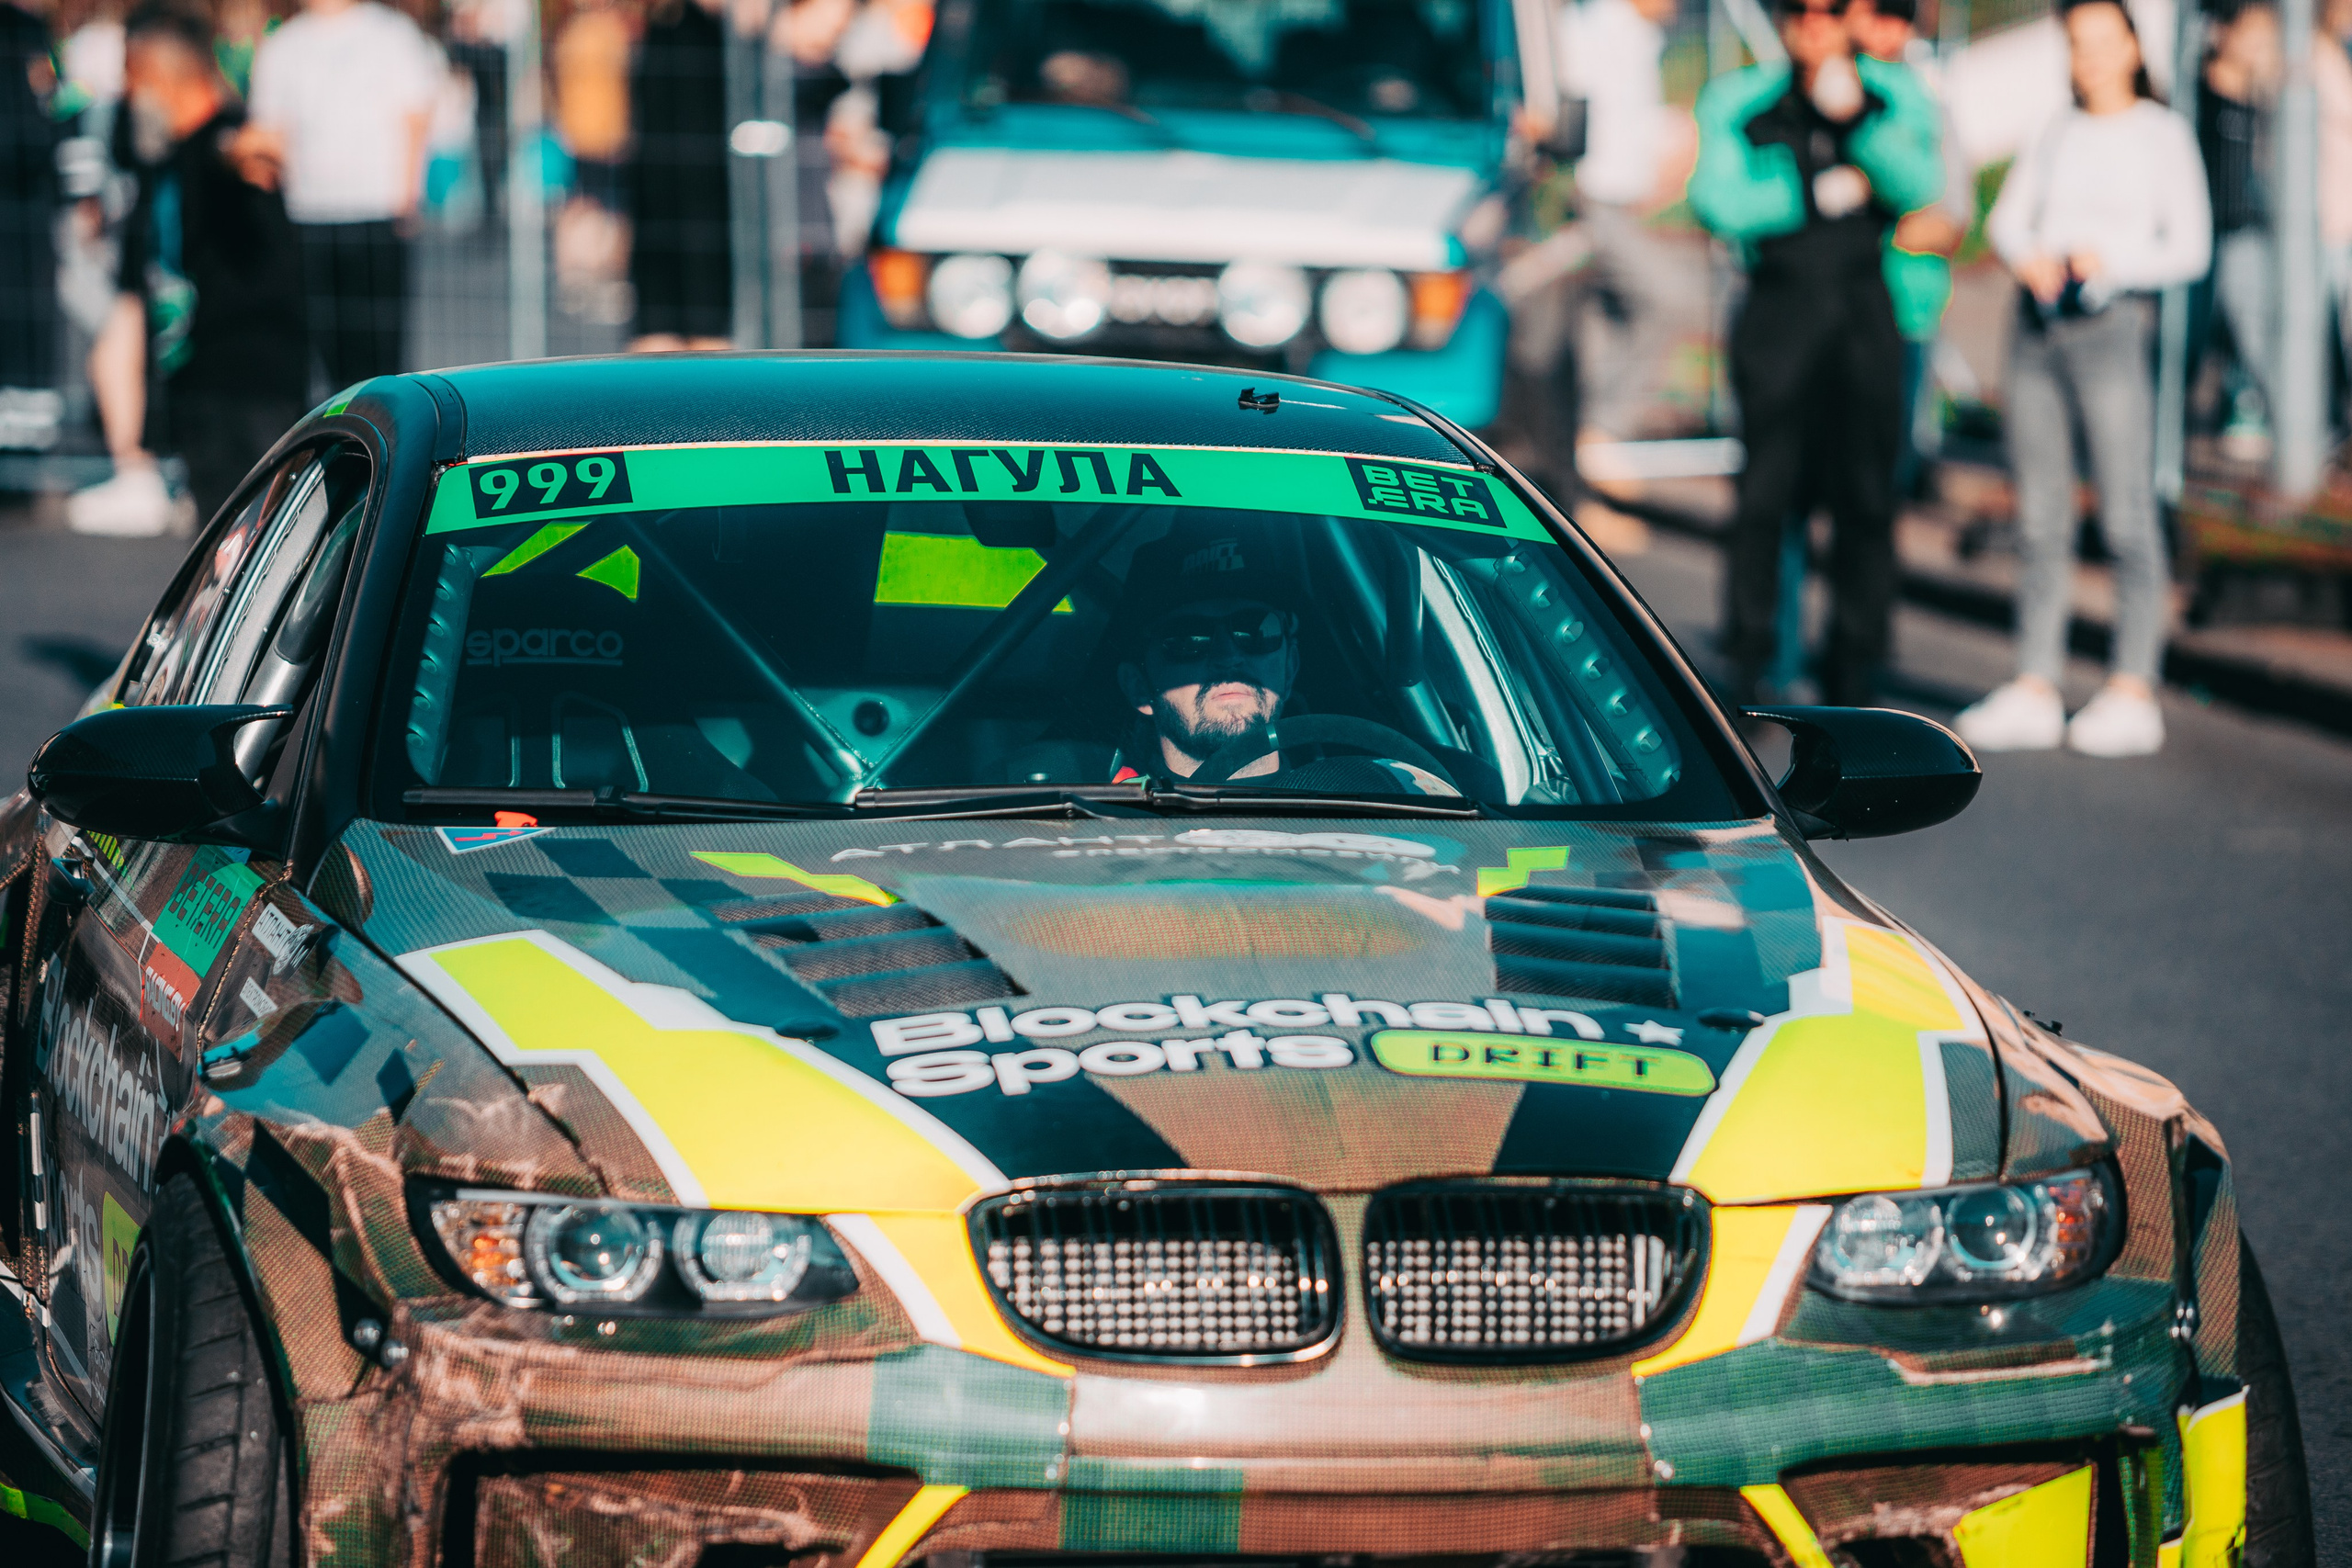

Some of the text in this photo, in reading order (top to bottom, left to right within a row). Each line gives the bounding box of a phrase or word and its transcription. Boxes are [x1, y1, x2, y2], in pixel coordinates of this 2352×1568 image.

[479, 457, 616, 510] 999
[824, 449, 1182, 497] НАГУЛА
[1362, 465, 1474, 497] BET
[1368, 486, 1489, 520] ERA
[466, 628, 623, 667] sparco
[168, 863, 241, 949] BETERA
[870, 993, 1605, 1056] Blockchain
[36, 951, 154, 1192] Blockchain
[886, 1029, 1660, 1098] Sports DRIFT
